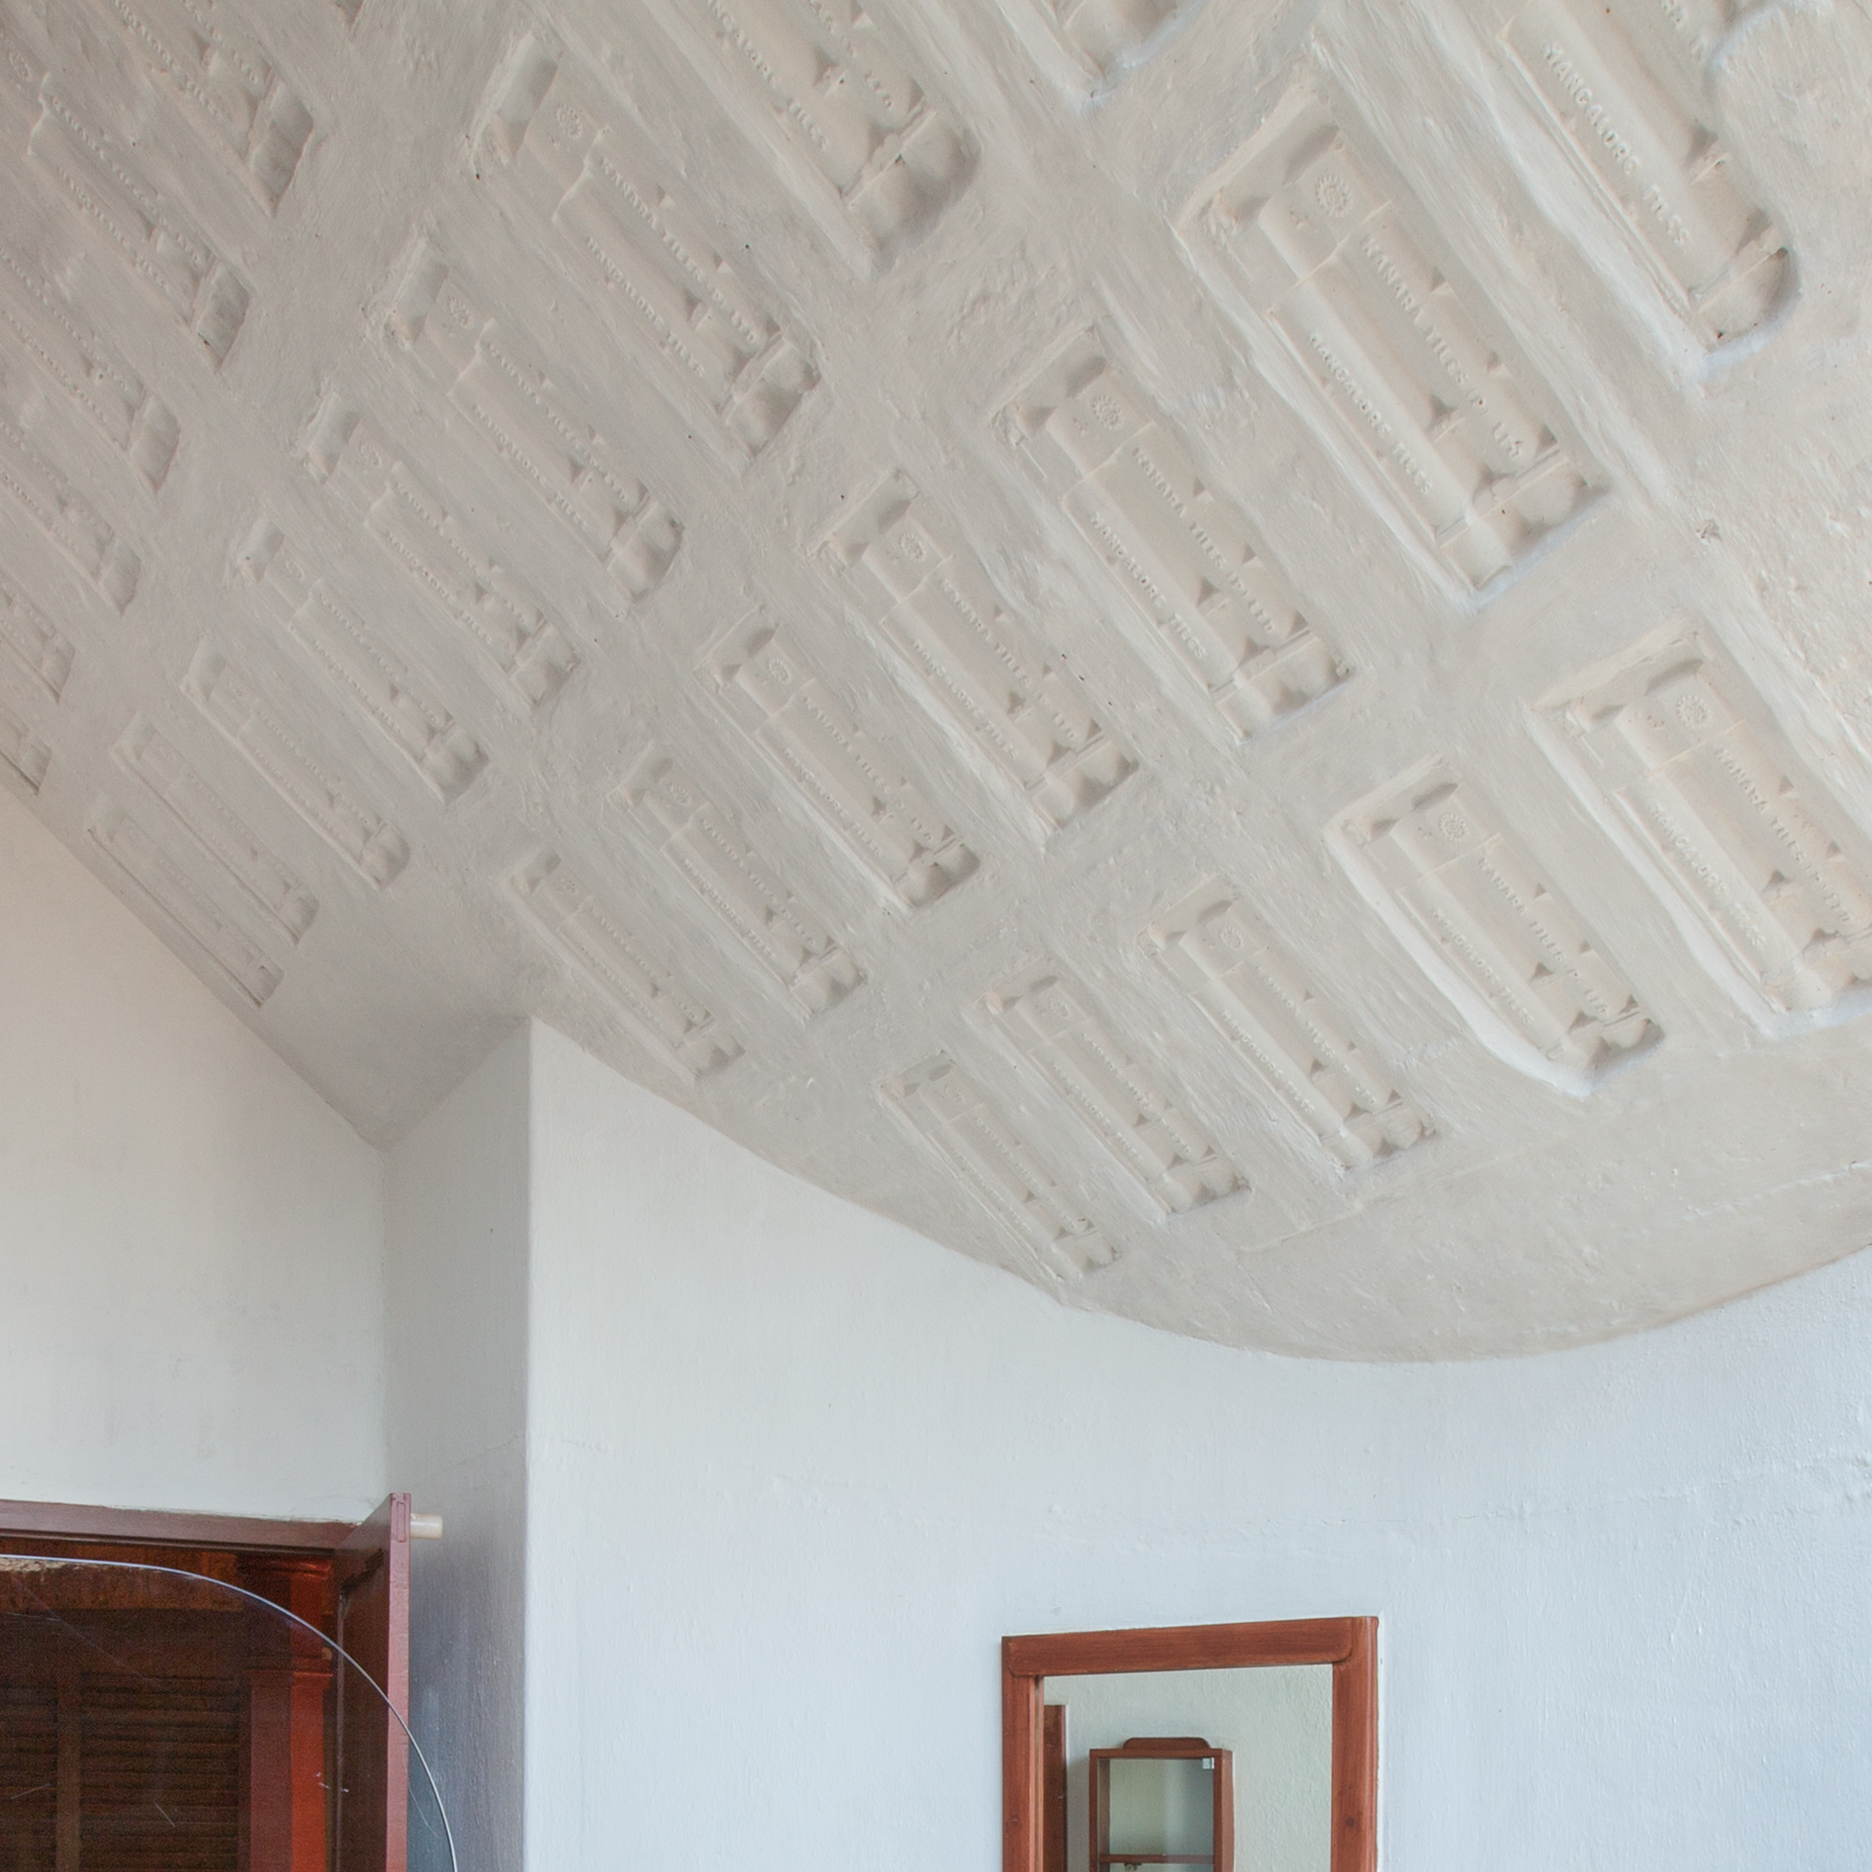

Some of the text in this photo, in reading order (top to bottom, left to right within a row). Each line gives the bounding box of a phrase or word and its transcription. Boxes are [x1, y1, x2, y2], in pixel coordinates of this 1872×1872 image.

[783, 95, 831, 151] TILES
[1539, 40, 1692, 247] MANGALORE TILES
[581, 233, 708, 379] MANGALORE TILES
[596, 154, 661, 230] KANARA
[658, 227, 707, 283] TILES
[727, 308, 759, 345] LTD
[1356, 234, 1428, 324] KANARA
[1421, 325, 1470, 386] TILES
[1306, 329, 1434, 495] MANGALORE TILES
[1086, 511, 1209, 660] MANGALORE TILES
[1129, 446, 1189, 518] KANARA
[1187, 520, 1228, 569] TILES
[1246, 598, 1278, 634] LTD
[799, 695, 854, 754] KANARA
[909, 637, 1020, 761] MANGALORE TILES
[937, 576, 994, 642] KANARA
[992, 642, 1034, 689] TILES
[1050, 711, 1077, 742] LTD
[1713, 745, 1771, 814] KANARA
[1477, 854, 1528, 918] KANARA
